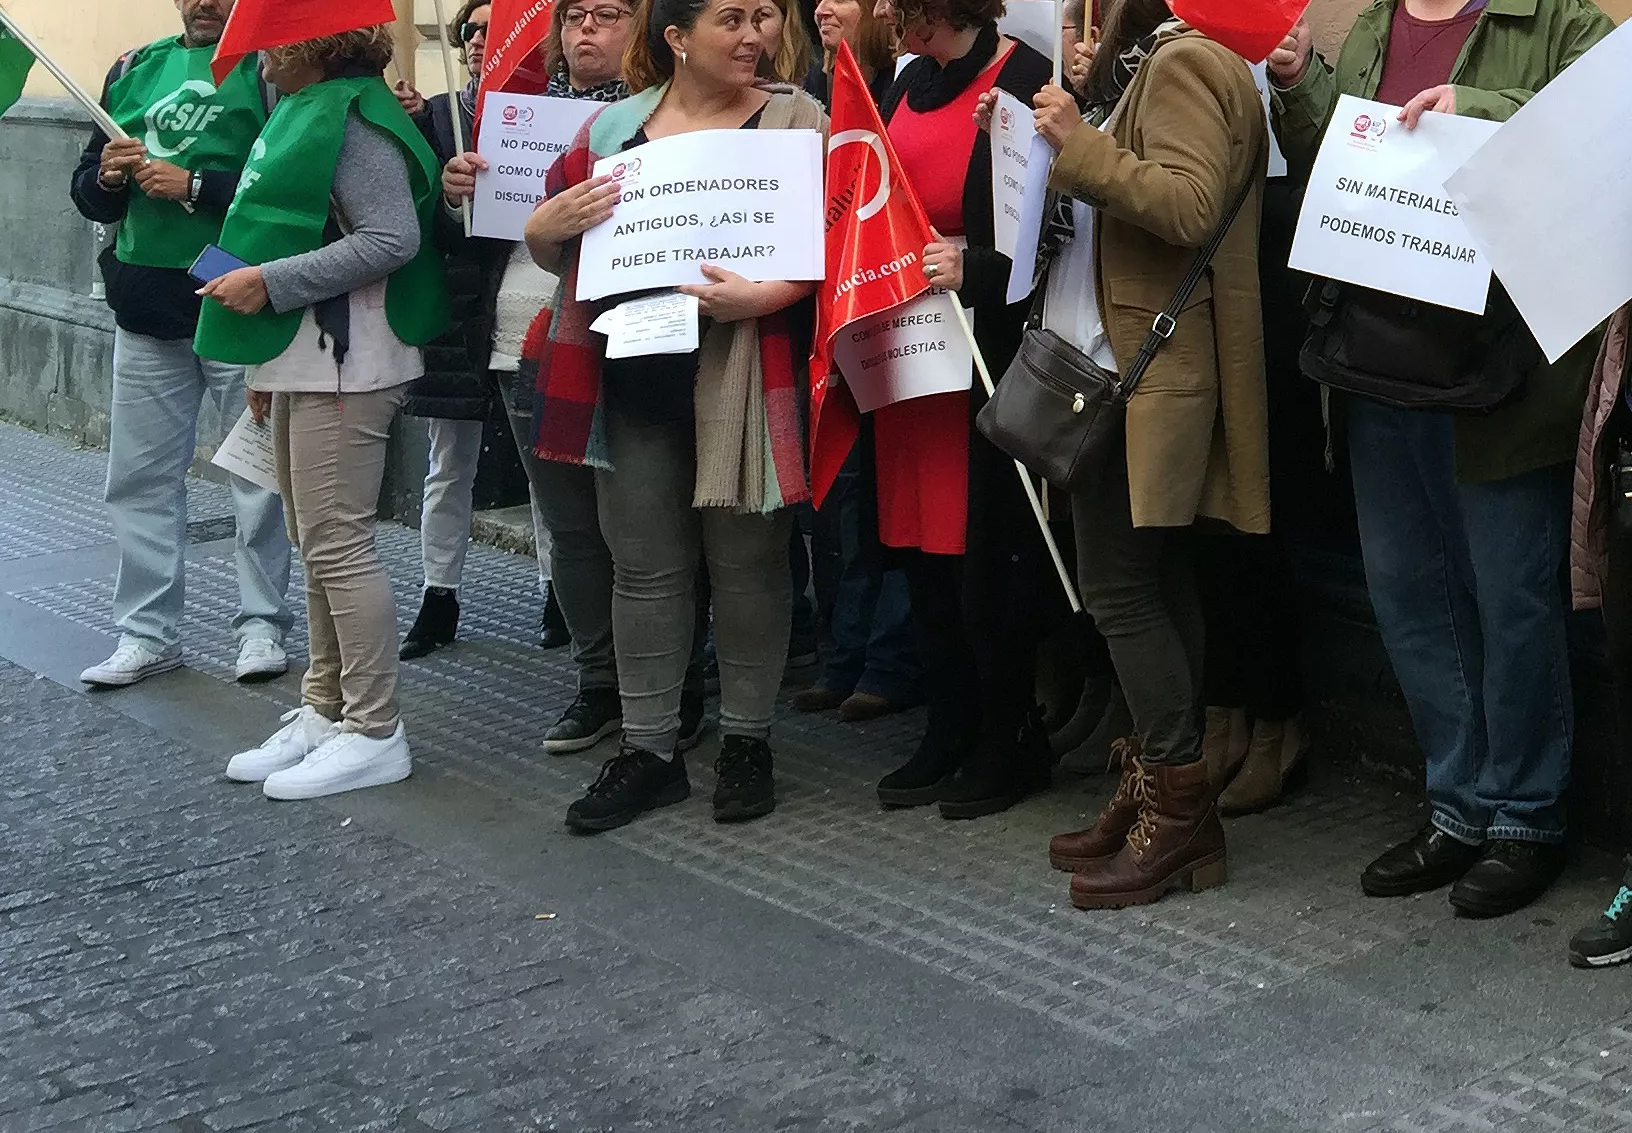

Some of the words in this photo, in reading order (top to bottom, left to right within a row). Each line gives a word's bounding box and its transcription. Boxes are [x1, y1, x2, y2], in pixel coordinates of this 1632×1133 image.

[157, 103, 224, 131] CSIF
[501, 139, 518, 149] NO
[498, 165, 532, 177] COMO
[650, 178, 780, 197] ORDENADORES
[1336, 177, 1363, 194] SIN
[1365, 183, 1459, 217] MATERIALES
[613, 214, 704, 238] ANTIGUOS,
[753, 212, 775, 224] SE
[1320, 214, 1396, 245] PODEMOS
[1401, 234, 1476, 264] TRABAJAR
[611, 250, 667, 270] PUEDE
[672, 245, 776, 261] TRABAJAR?
